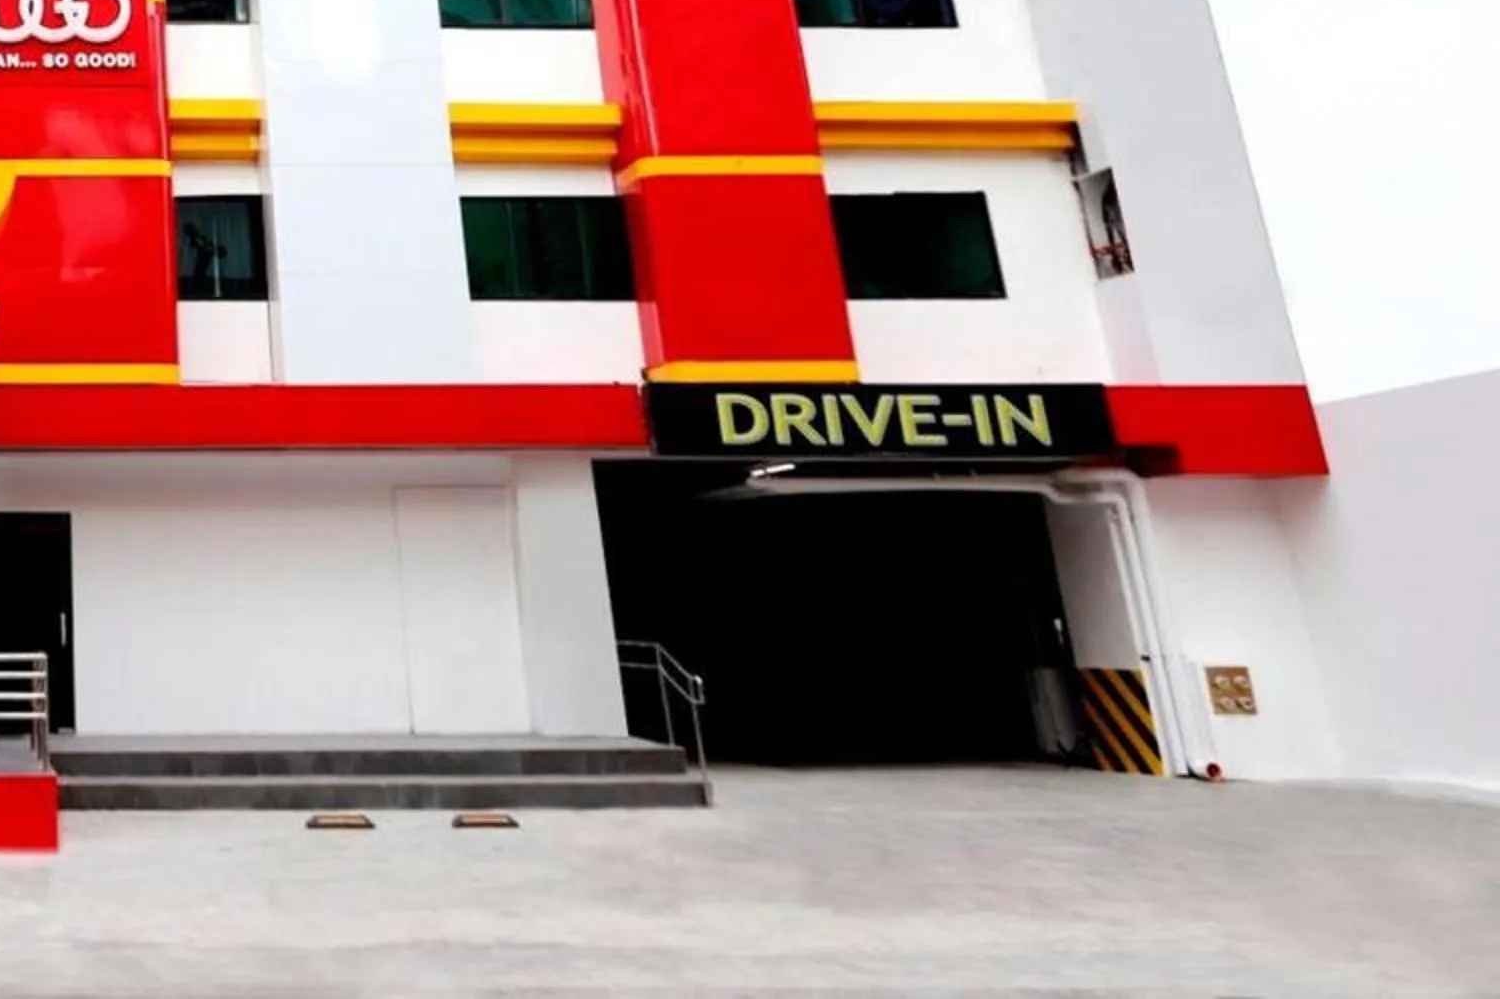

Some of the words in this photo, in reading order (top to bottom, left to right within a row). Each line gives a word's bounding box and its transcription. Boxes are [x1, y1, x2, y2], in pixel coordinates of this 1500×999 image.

[42, 54, 69, 68] SO
[74, 54, 136, 69] GOOD!
[715, 394, 1053, 446] DRIVE-IN
